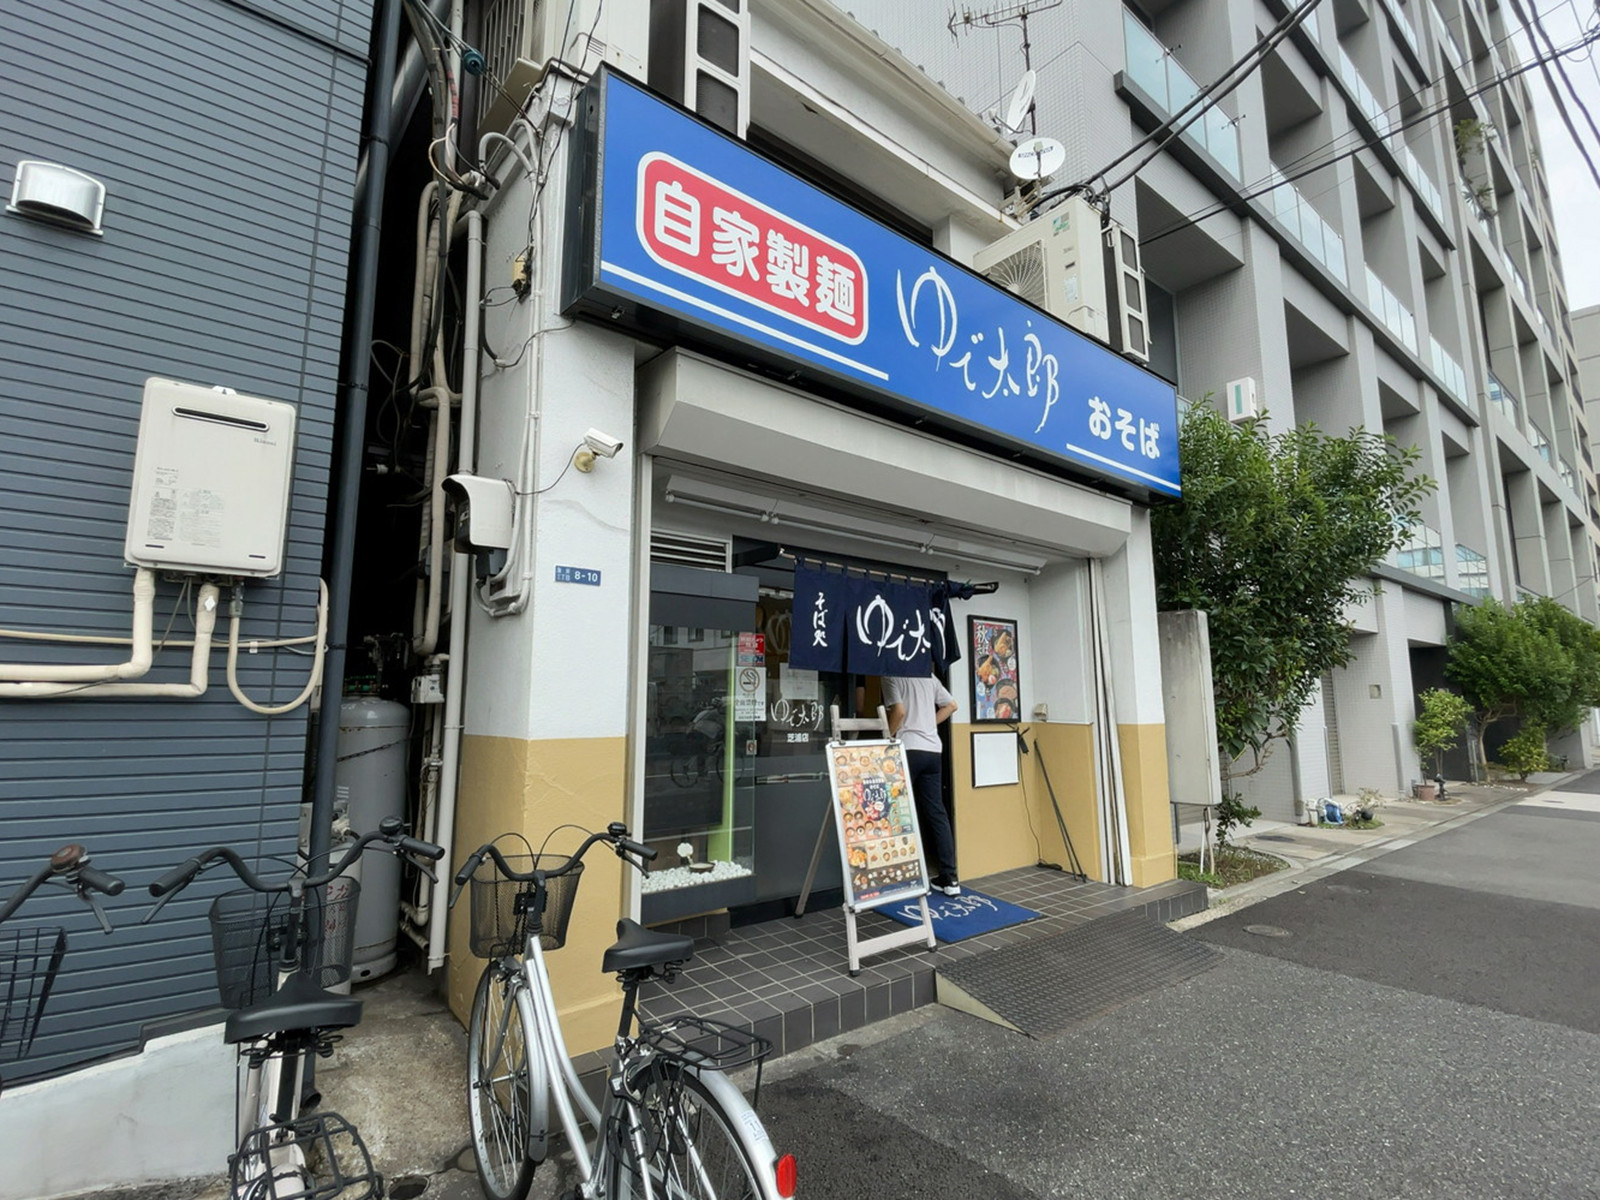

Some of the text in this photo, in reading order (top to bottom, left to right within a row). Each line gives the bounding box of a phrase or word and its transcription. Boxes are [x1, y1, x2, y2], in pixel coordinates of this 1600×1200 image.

[654, 180, 856, 327] 自家製麺
[896, 266, 1060, 434] ゆで太郎
[1088, 396, 1160, 459] おそば
[574, 570, 598, 582] 8-10
[812, 592, 829, 647] そば処
[770, 699, 825, 731] ゆで太郎
